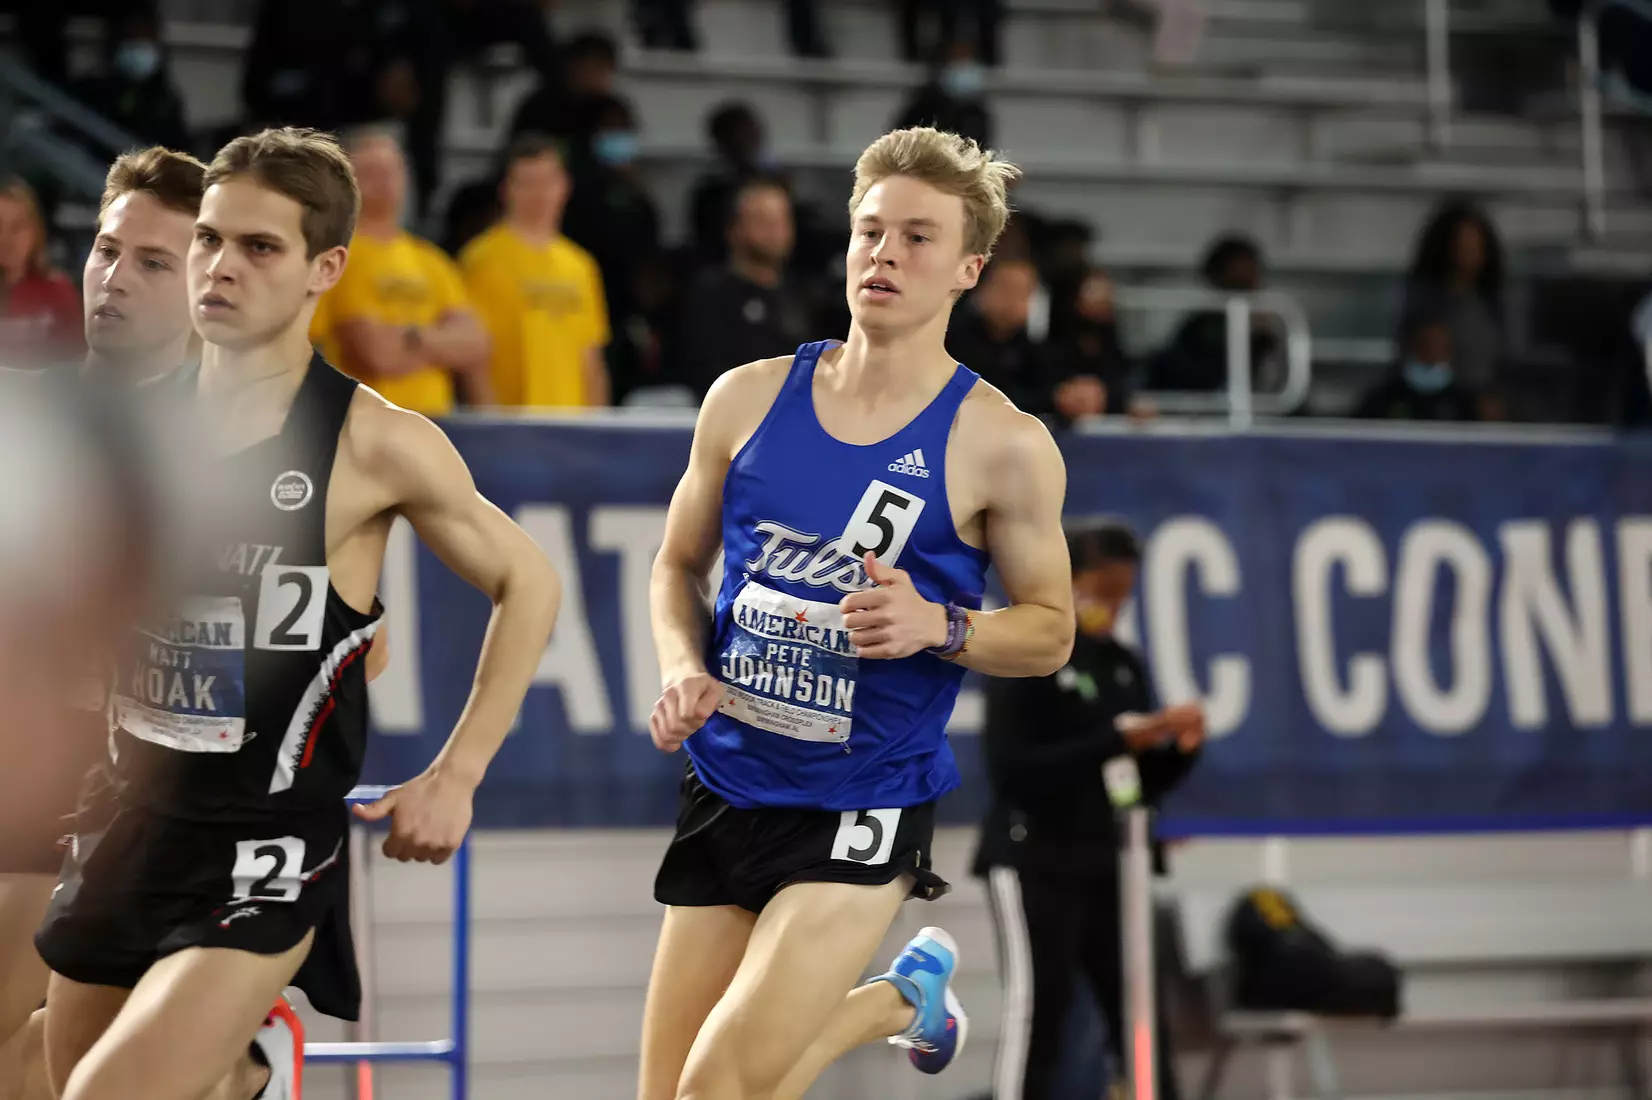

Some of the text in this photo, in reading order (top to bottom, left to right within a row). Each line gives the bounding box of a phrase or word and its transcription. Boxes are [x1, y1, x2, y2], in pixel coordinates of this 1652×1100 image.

[888, 462, 930, 478] adidas
[852, 489, 911, 559] 5
[269, 571, 313, 645] 2
[738, 604, 852, 654] AMERICAN
[766, 642, 812, 667] PETE
[721, 651, 856, 712] JOHNSON
[847, 809, 883, 862] 5
[249, 844, 287, 897] 2
